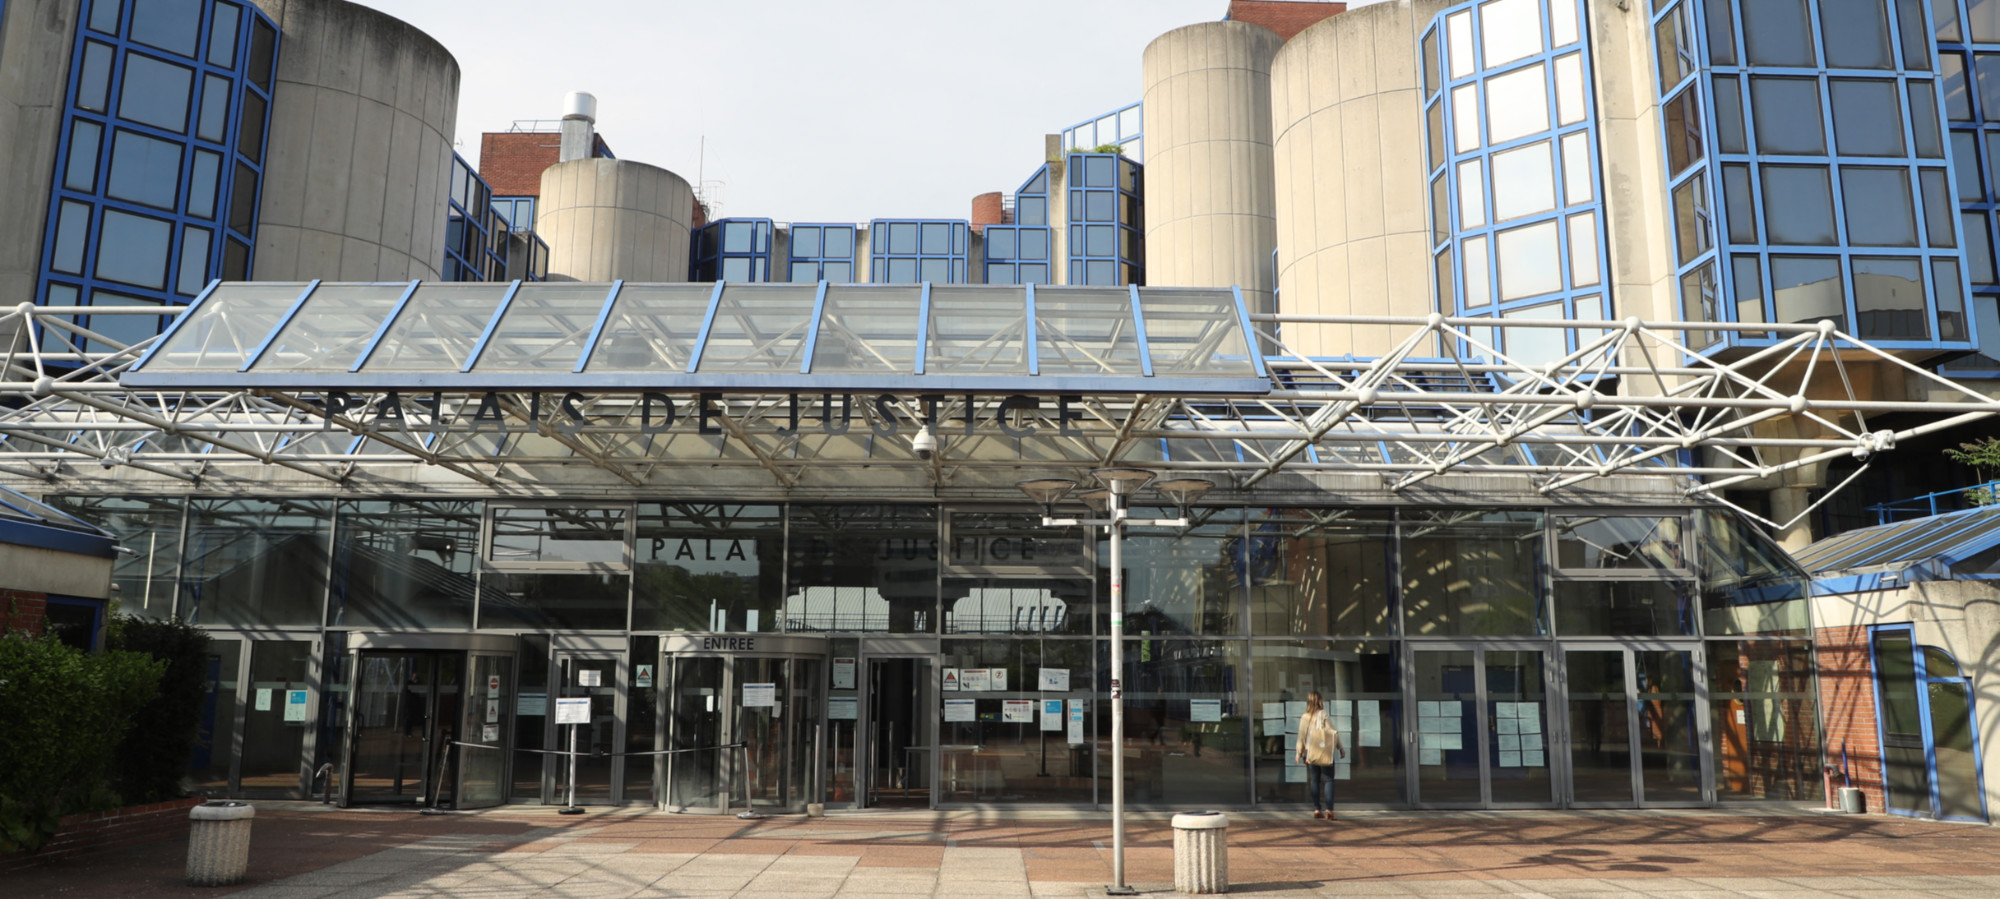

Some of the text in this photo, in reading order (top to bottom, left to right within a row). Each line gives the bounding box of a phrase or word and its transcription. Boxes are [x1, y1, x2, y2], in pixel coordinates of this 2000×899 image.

[323, 391, 1083, 437] PALAIS DE JUSTICE
[703, 637, 754, 650] ENTREE
